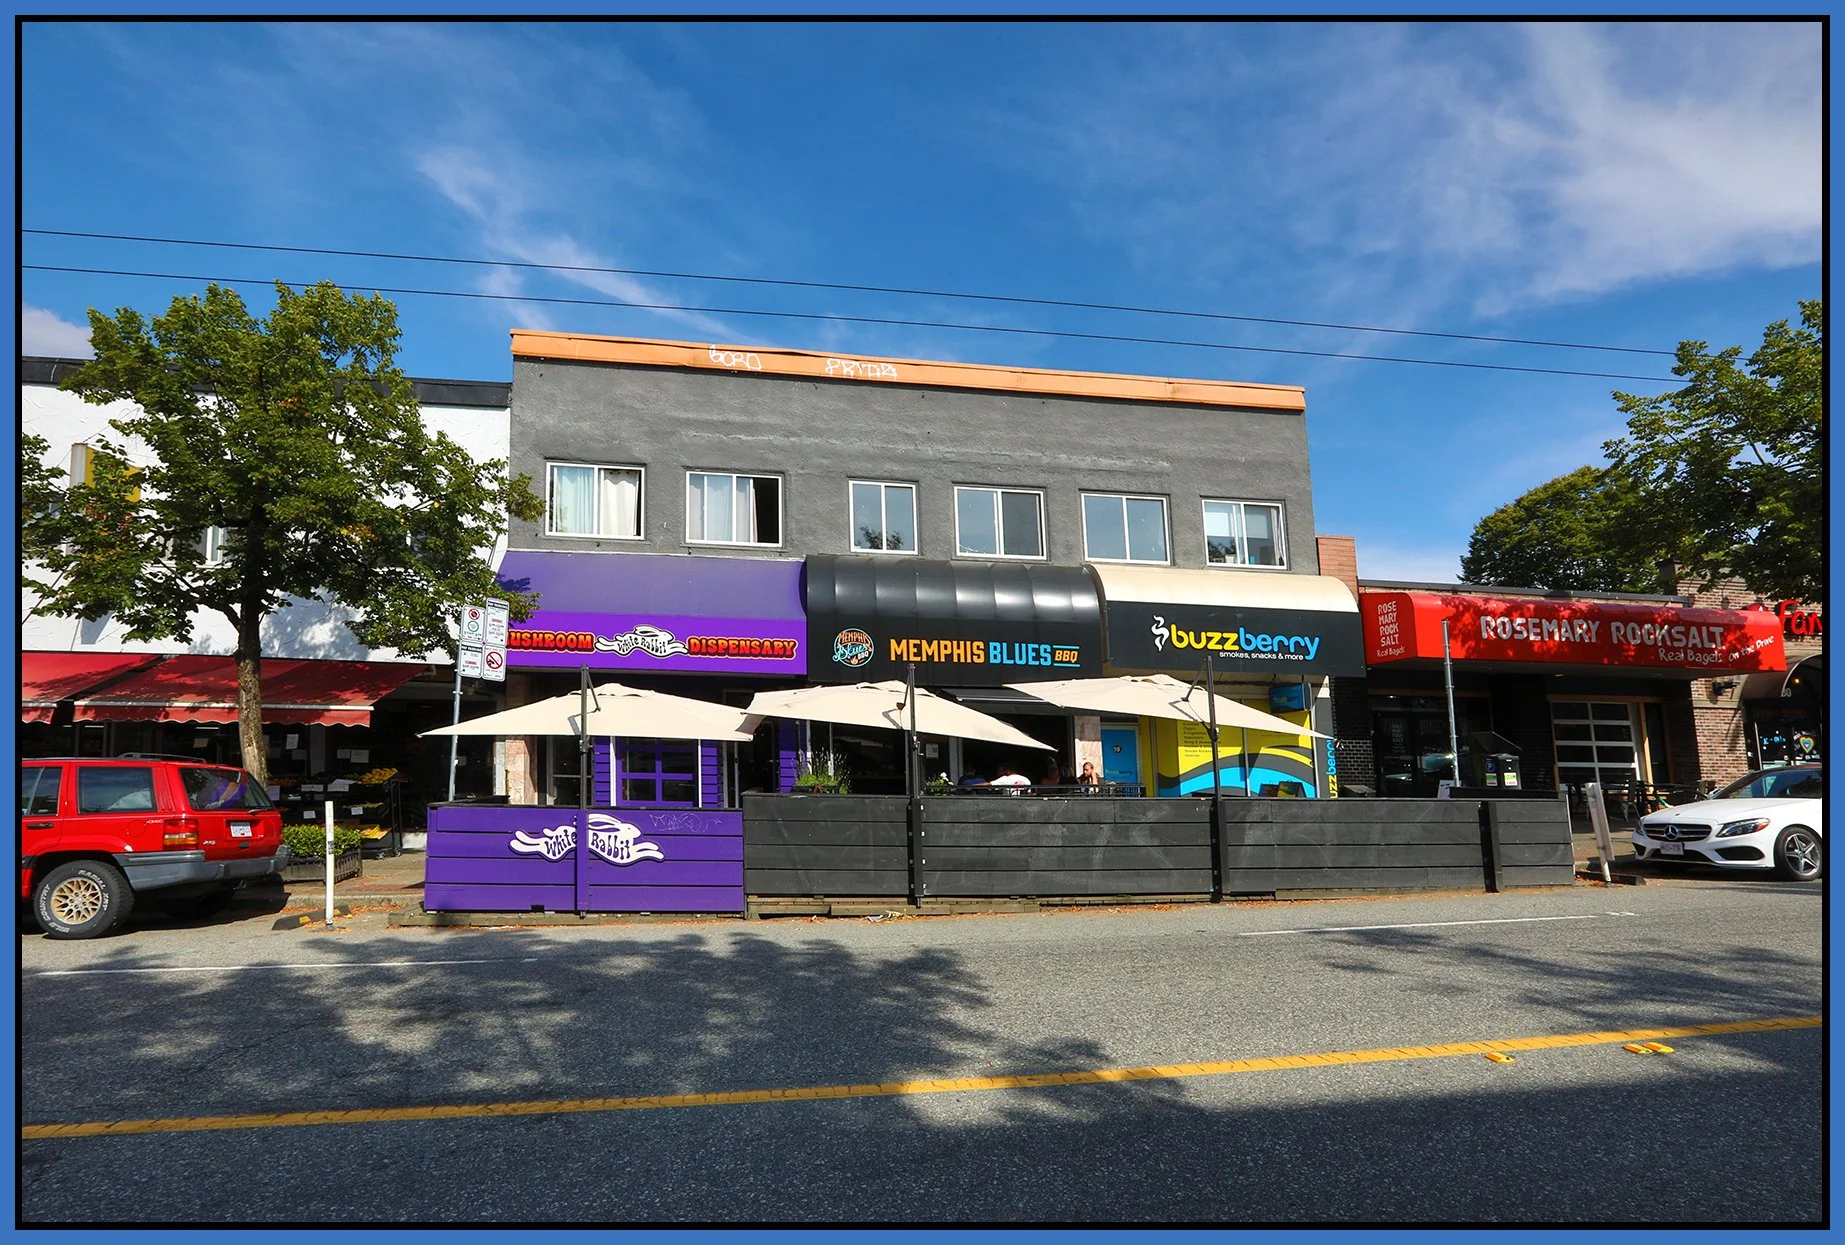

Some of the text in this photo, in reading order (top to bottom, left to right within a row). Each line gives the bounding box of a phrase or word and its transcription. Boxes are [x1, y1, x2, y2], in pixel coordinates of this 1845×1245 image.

[1377, 600, 1397, 615] ROSE
[1378, 612, 1398, 626] MARY
[1380, 622, 1399, 637] ROCK
[1480, 615, 1725, 649] ROSEMARY ROCKSALT
[508, 631, 593, 650] USHROOM
[617, 635, 667, 654] White Rabbit
[689, 637, 795, 657] DISPENSARY
[838, 631, 872, 648] MEMPHIS
[1170, 623, 1320, 661] buzzberry
[1380, 634, 1399, 647] SALT
[890, 638, 1051, 666] MEMPHIS BLUES
[1054, 649, 1078, 661] BBQ
[1219, 651, 1250, 659] smokes,
[1658, 647, 1722, 665] Real Bagels
[544, 829, 631, 860] White Rabbit
